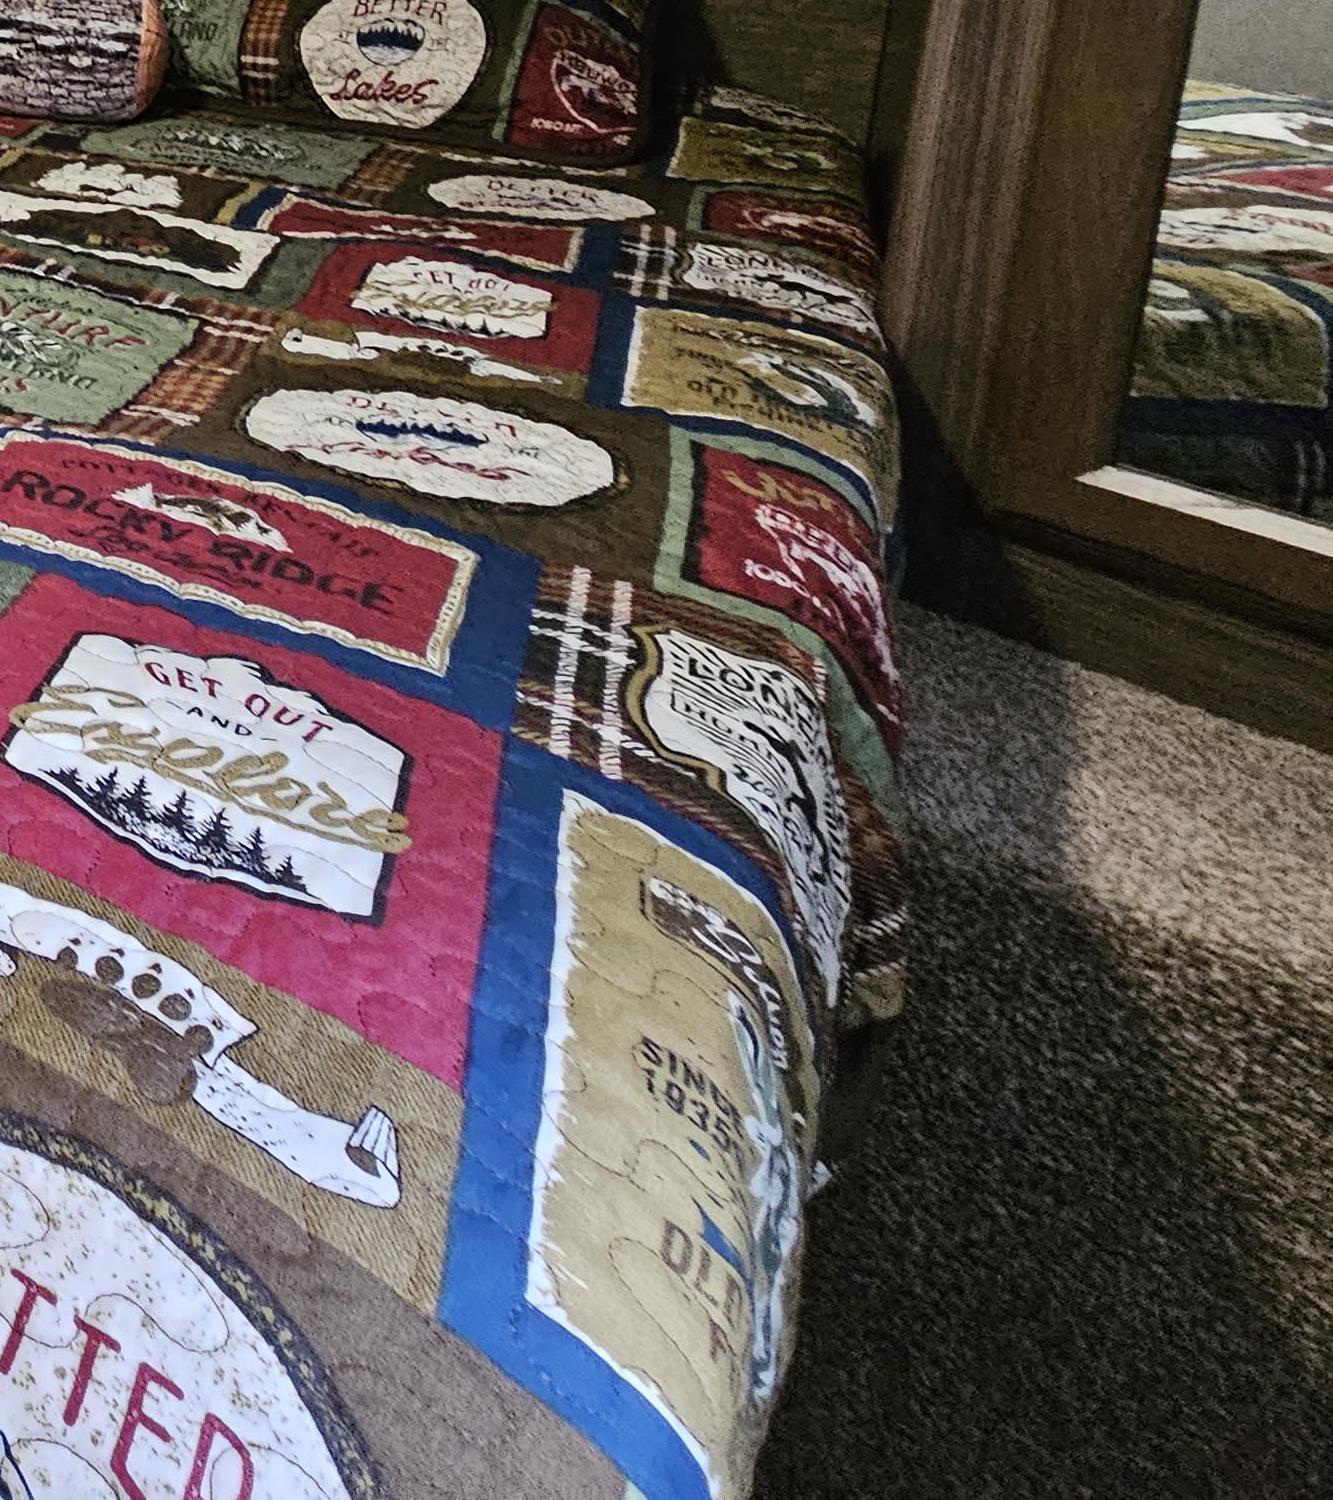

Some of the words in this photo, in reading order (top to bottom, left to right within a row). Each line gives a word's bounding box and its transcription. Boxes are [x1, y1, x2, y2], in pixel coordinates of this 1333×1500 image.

[329, 67, 440, 105] Lakes
[0, 468, 192, 542] ROCKY
[209, 540, 403, 616] RIDGE
[144, 661, 223, 699] GET
[244, 693, 334, 743] OUT
[186, 706, 254, 737] AND
